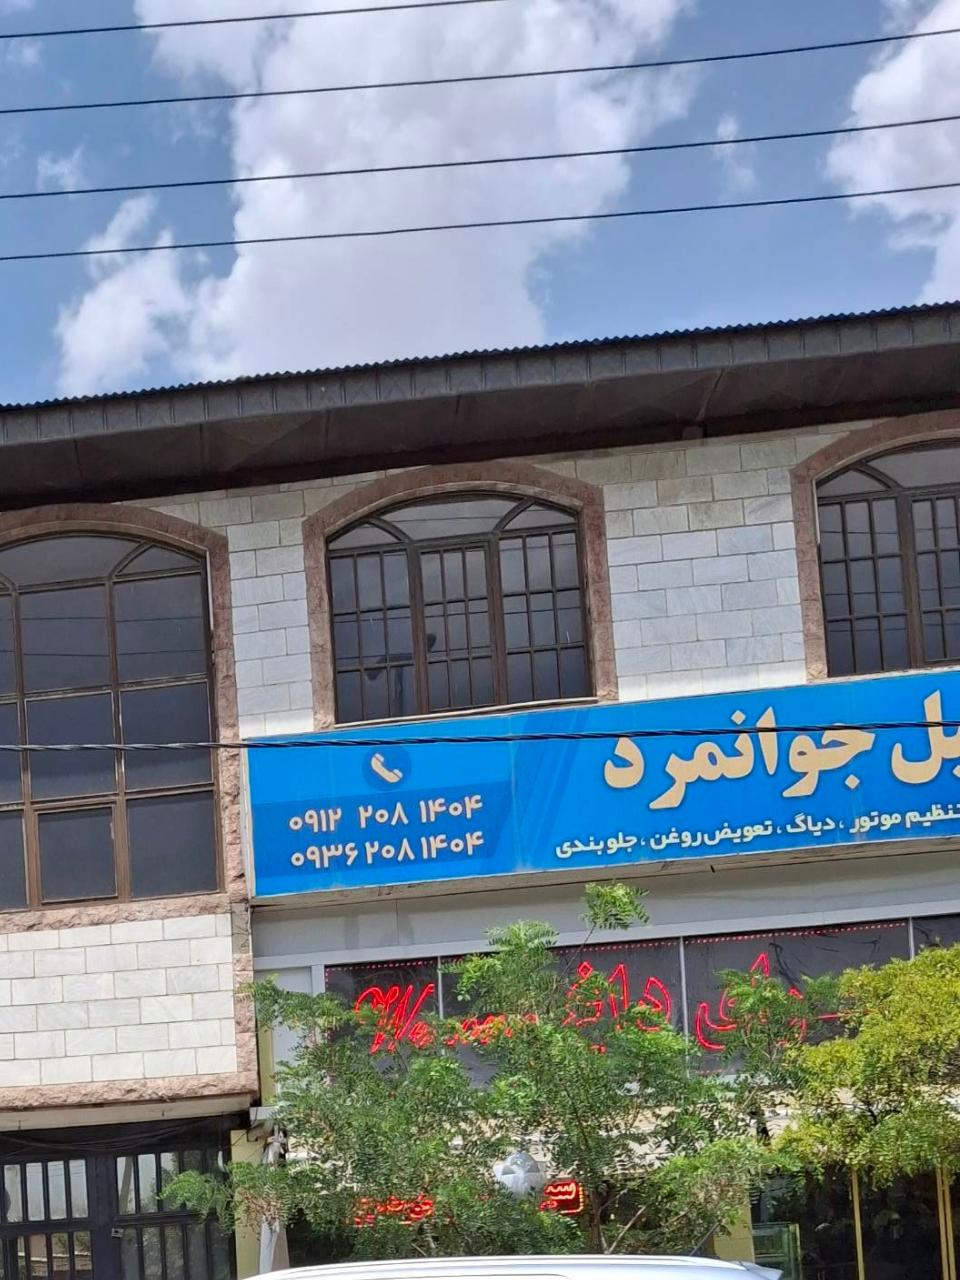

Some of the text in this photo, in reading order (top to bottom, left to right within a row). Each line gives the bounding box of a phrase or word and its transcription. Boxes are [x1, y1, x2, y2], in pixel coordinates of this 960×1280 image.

[289, 794, 483, 833] ۰۹۱۲ ۲۰۸ ۱۴۰۴
[290, 830, 484, 869] ۰۹۳۶ ۲۰۸ ۱۴۰۴
